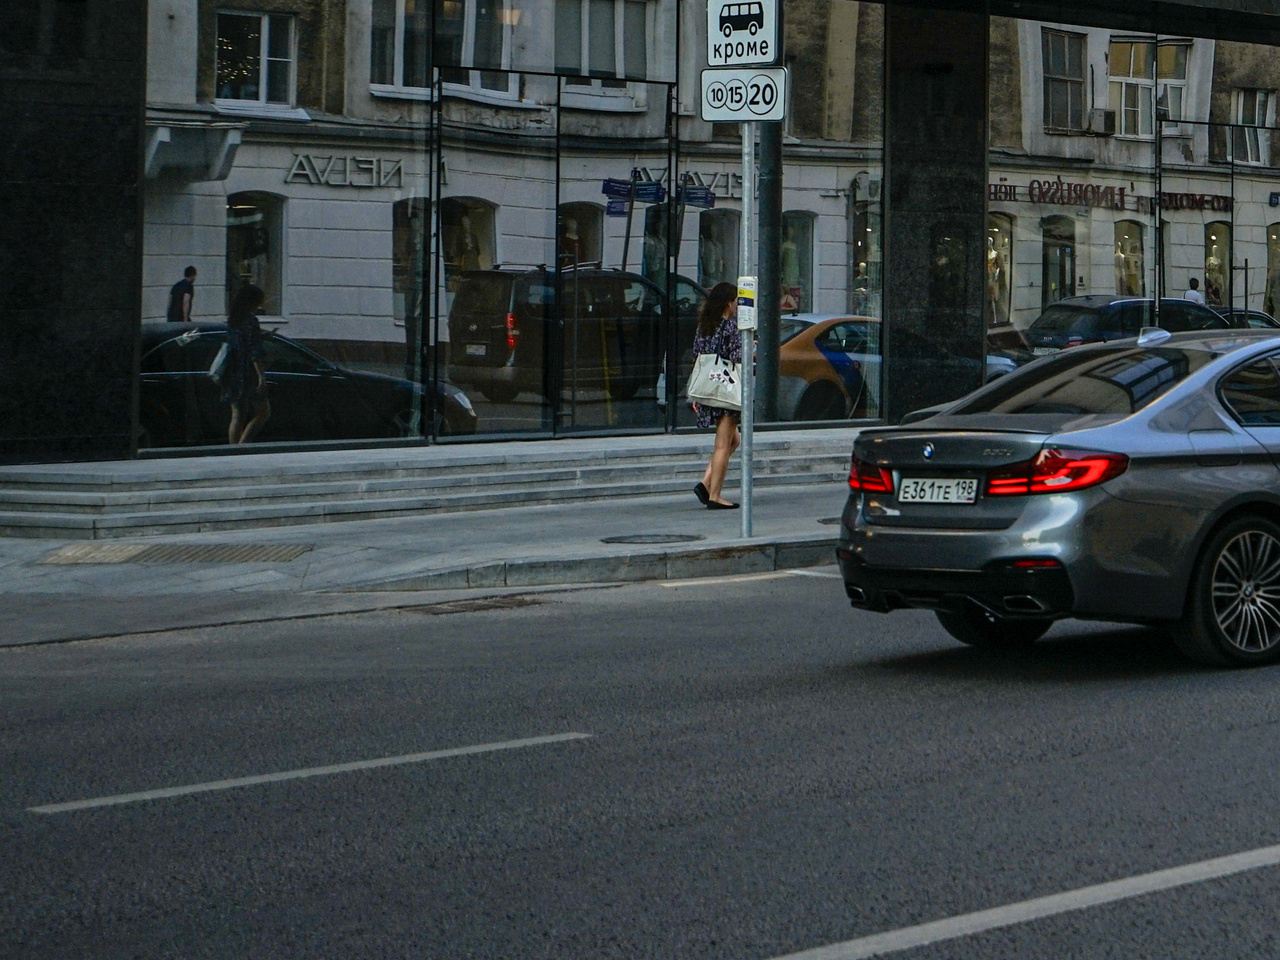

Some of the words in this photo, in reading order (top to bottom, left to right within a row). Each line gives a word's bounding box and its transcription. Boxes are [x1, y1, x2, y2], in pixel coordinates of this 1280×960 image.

[713, 40, 769, 63] кроме
[710, 88, 724, 103] 10
[728, 86, 743, 104] 15
[749, 83, 774, 106] 20
[902, 480, 952, 500] Е361ТЕ
[955, 480, 974, 495] 198
